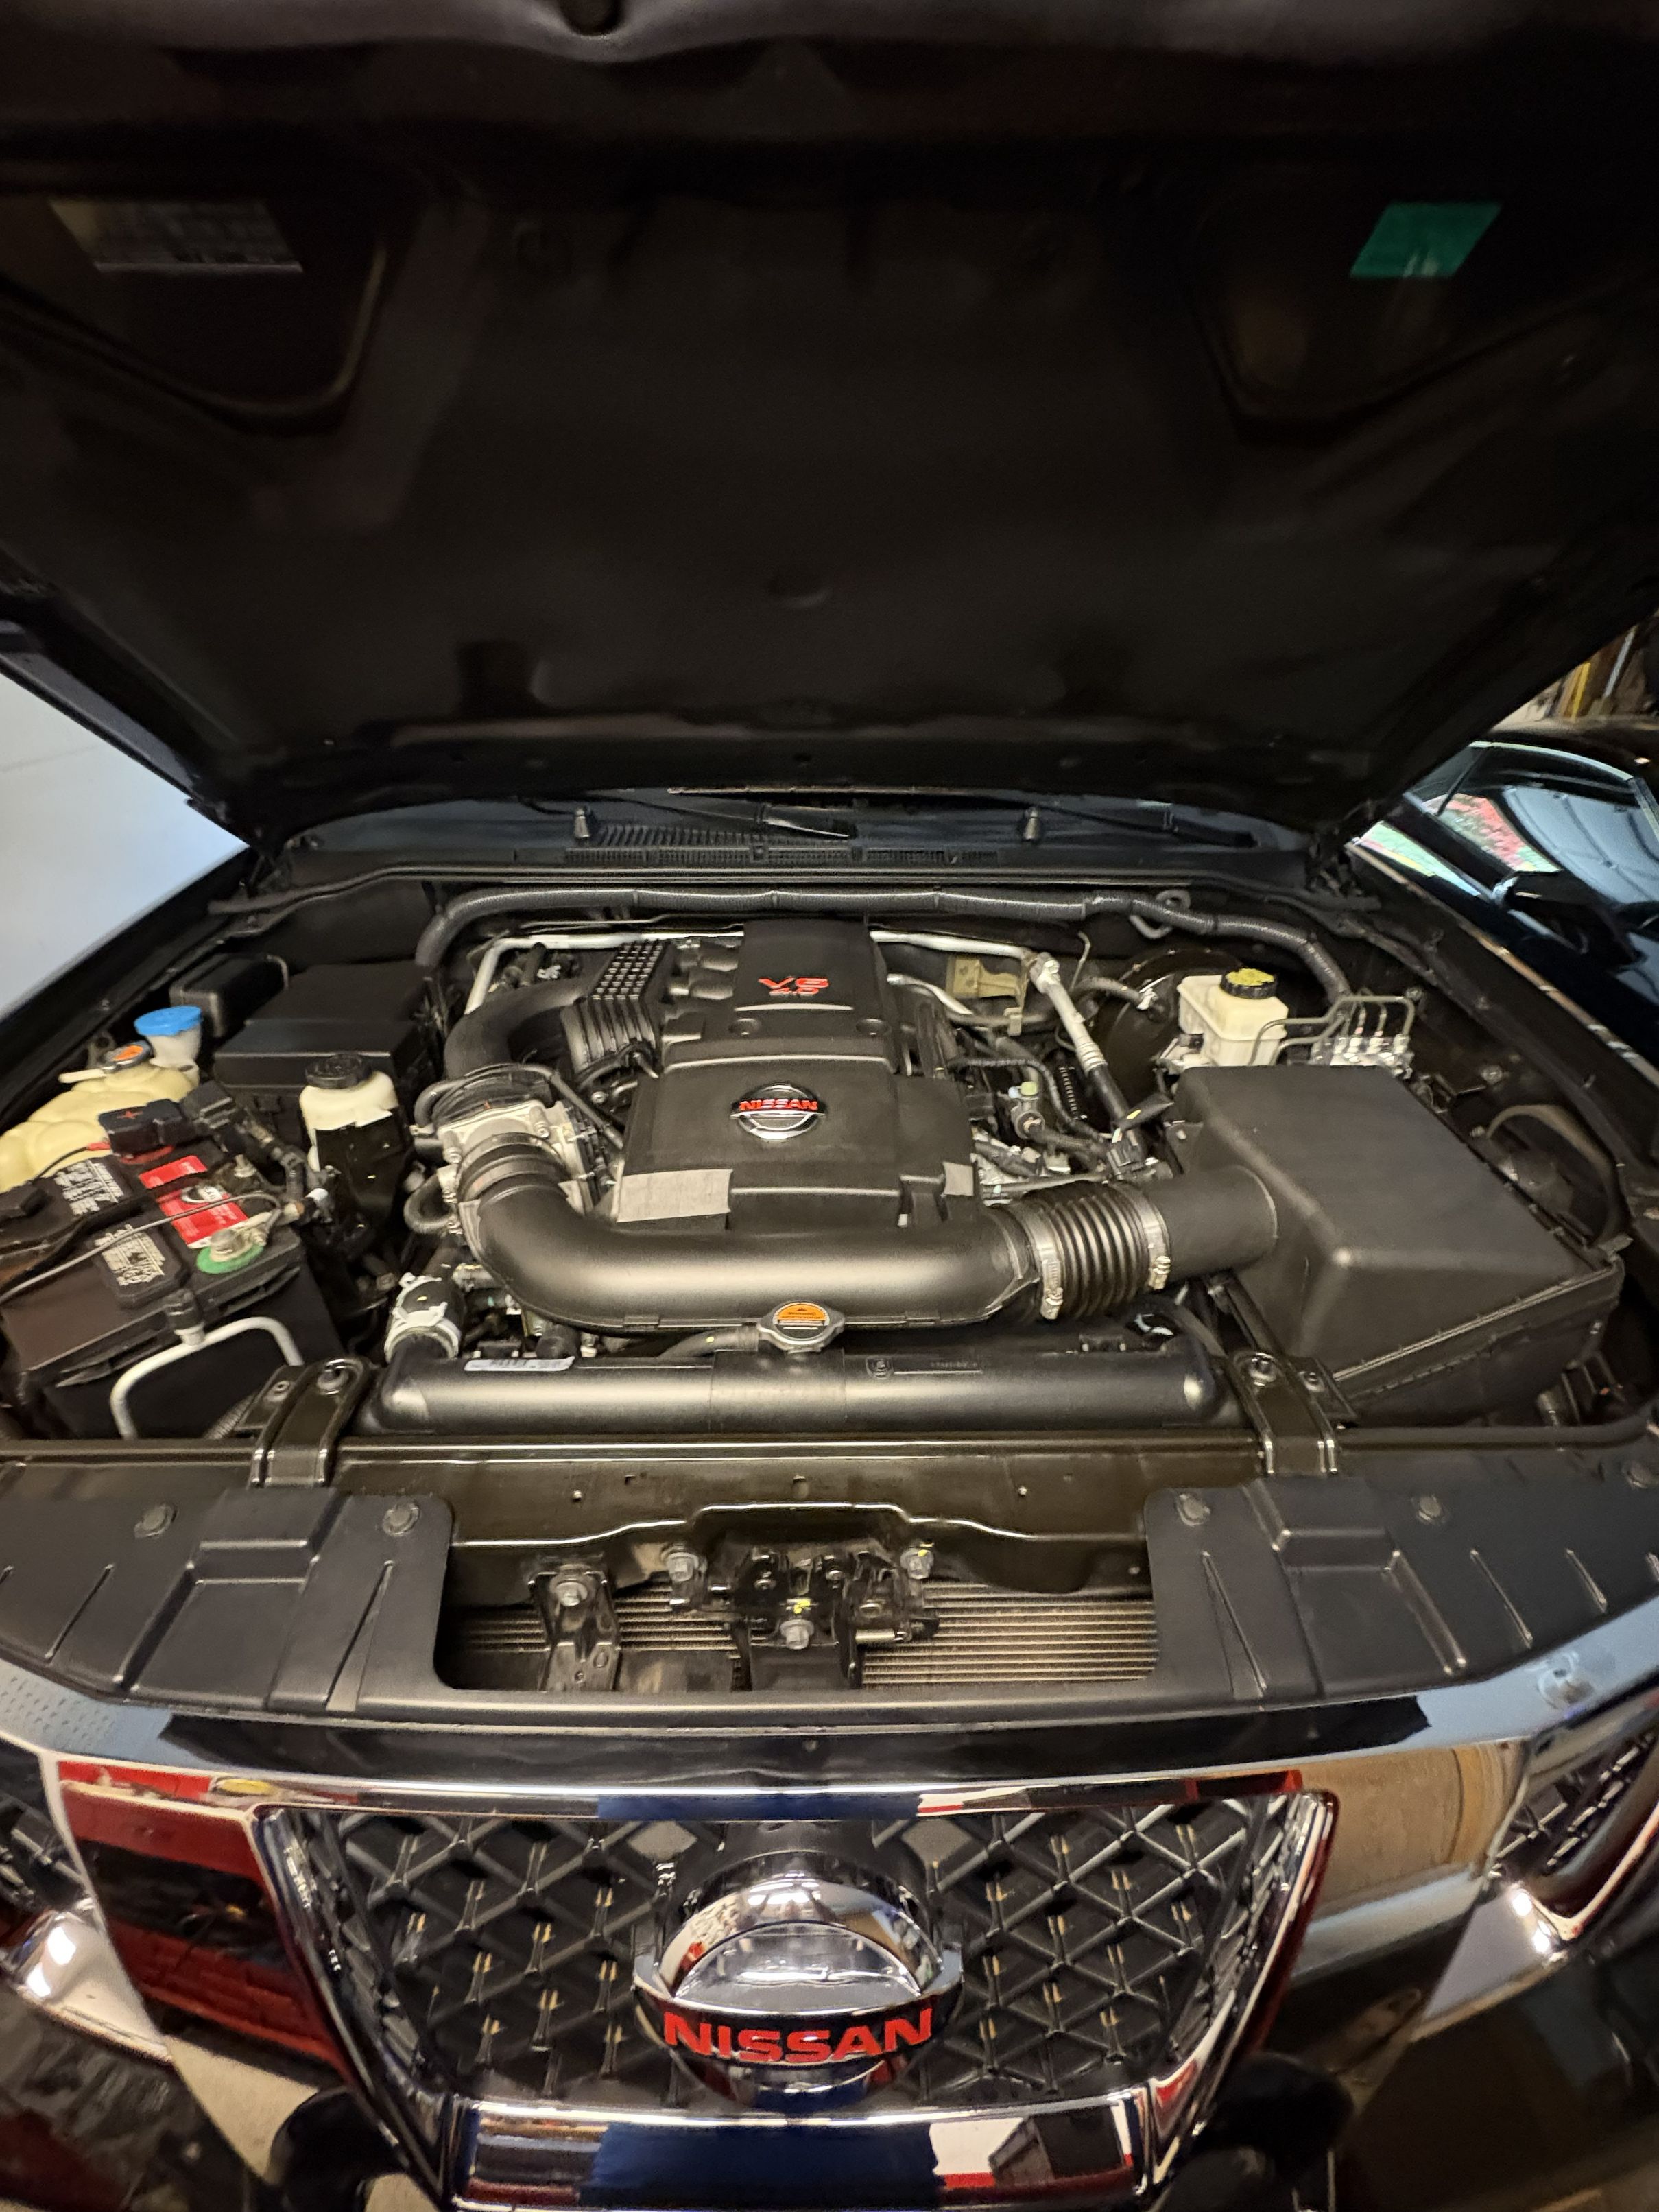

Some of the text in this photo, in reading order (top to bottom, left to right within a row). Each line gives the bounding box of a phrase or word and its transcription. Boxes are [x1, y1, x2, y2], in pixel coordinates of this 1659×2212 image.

[758, 976, 829, 988] V6
[739, 1099, 818, 1110] NISSAN
[663, 2008, 933, 2063] NISSAN
